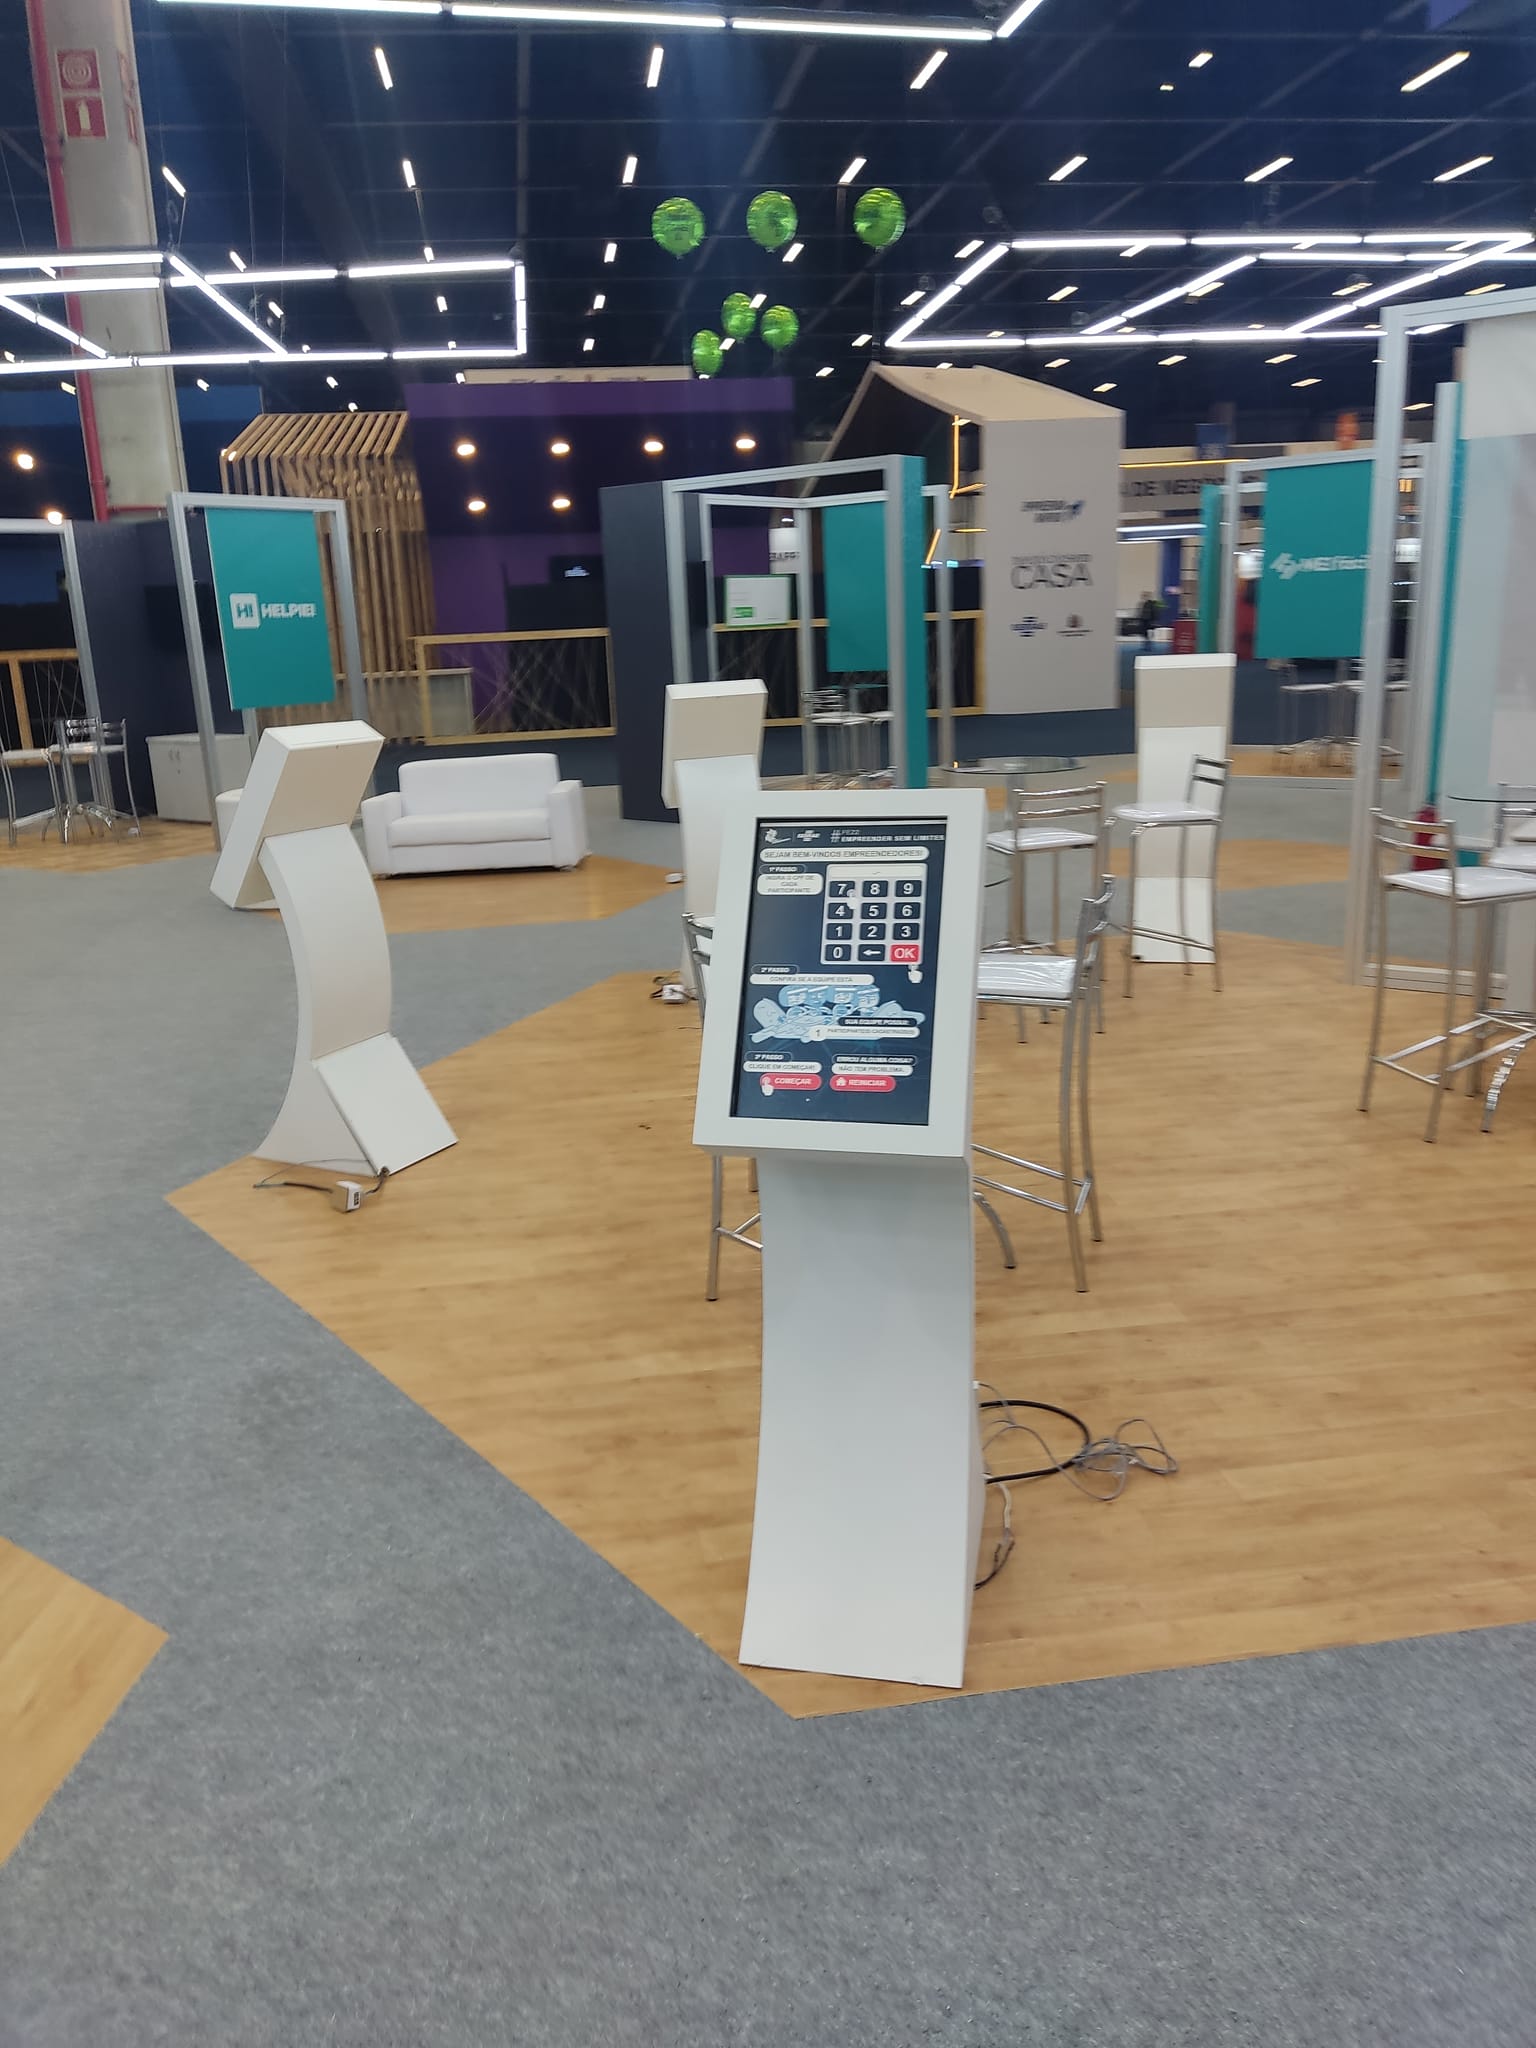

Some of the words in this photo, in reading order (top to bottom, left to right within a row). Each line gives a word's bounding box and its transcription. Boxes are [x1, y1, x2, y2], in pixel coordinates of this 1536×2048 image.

[1010, 563, 1093, 590] CASA
[792, 850, 840, 858] BEM-VINDOS
[837, 883, 847, 895] 7
[870, 883, 880, 895] 8
[903, 883, 914, 895] 9
[835, 905, 845, 917] 4
[868, 905, 879, 917] 5
[902, 905, 912, 917] 6
[835, 926, 843, 937] 1
[867, 926, 878, 938] 2
[901, 926, 912, 937] 3
[832, 947, 843, 959] 0
[894, 948, 916, 959] OK
[774, 1077, 812, 1086] COMEÇAR
